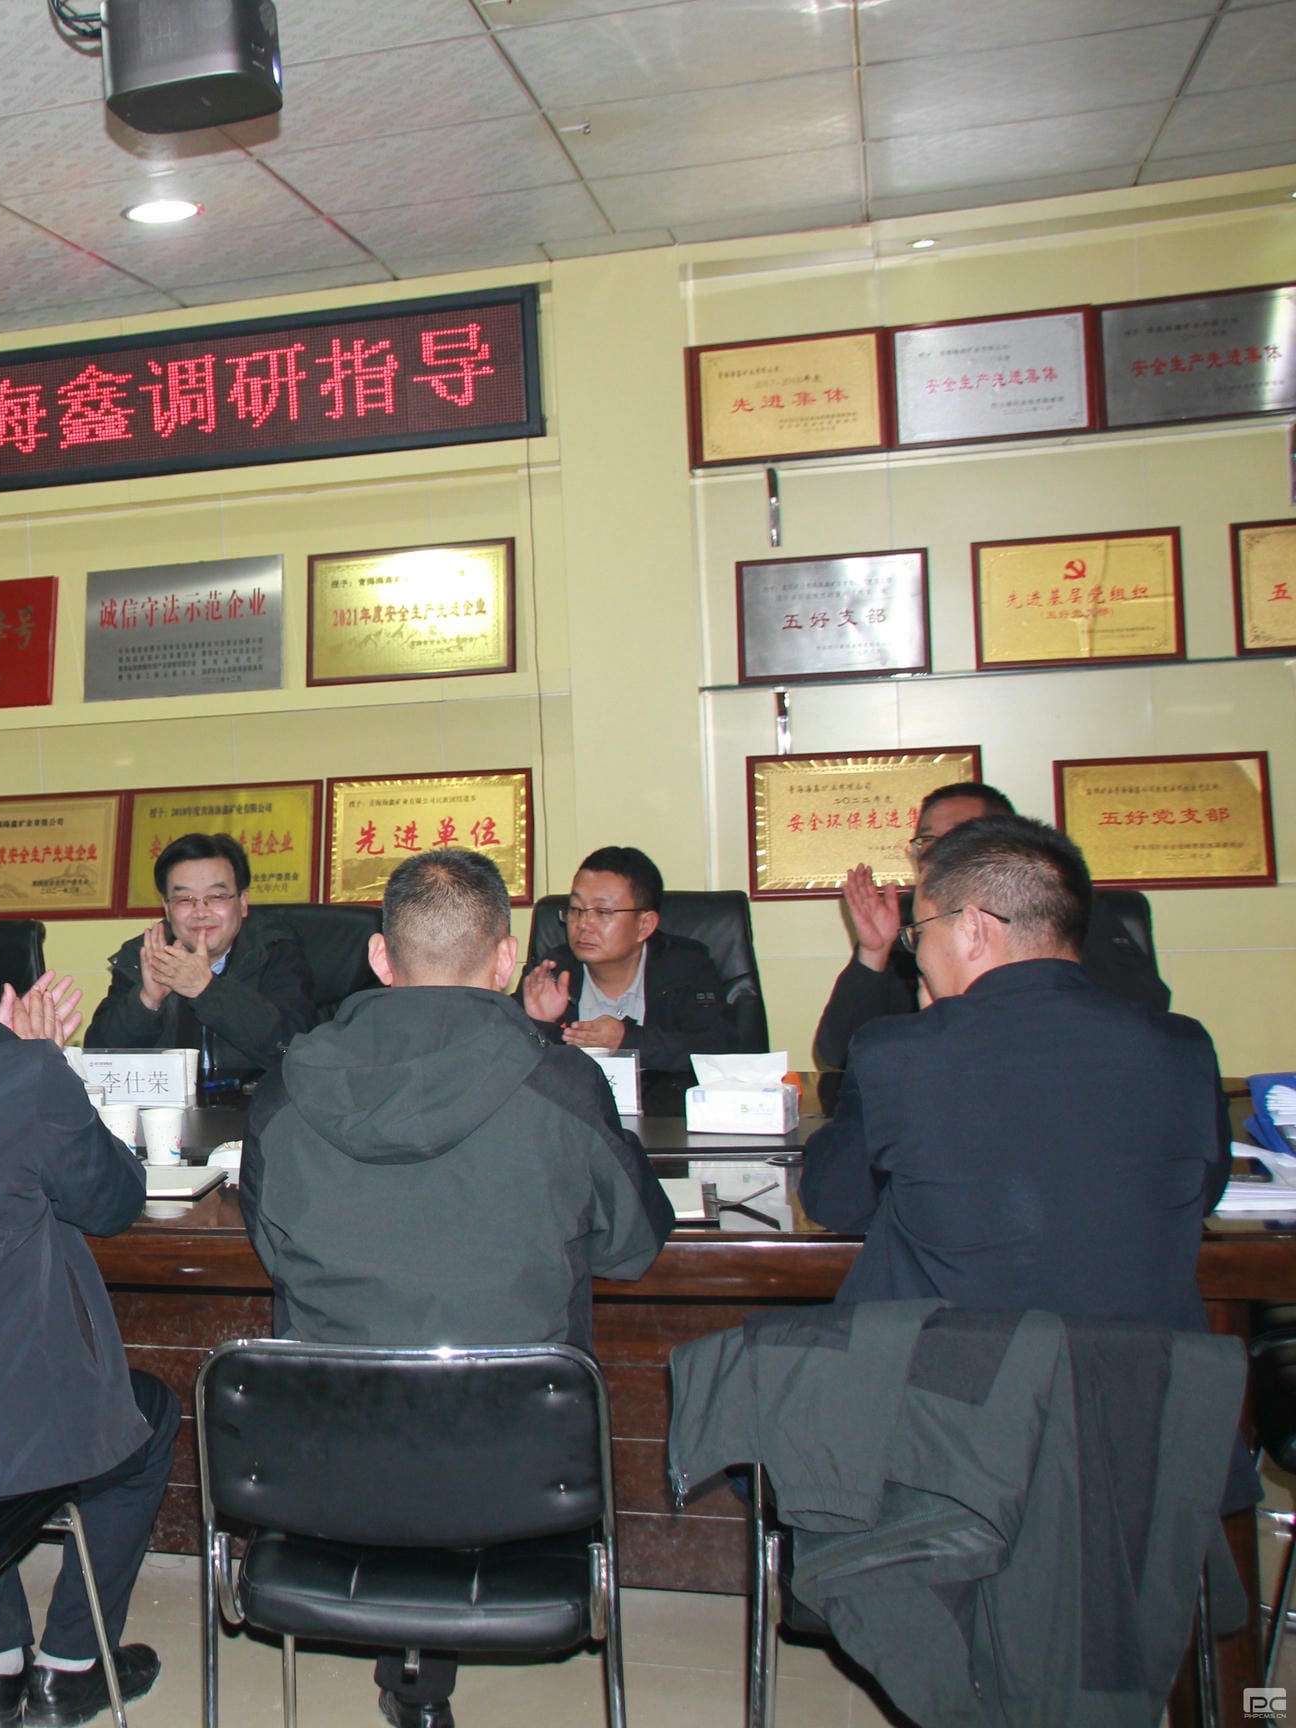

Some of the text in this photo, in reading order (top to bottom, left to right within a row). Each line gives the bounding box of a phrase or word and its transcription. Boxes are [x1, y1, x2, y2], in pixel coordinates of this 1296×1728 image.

[1131, 344, 1282, 377] 安全生产先进集体
[925, 366, 1058, 394] 安全生产先进集体
[731, 386, 849, 414] 先进集体
[1006, 583, 1150, 609] 先进基层党组织
[1266, 582, 1294, 602] 五
[98, 586, 267, 631] 诚信守法示范企业
[781, 607, 888, 632] 五好支部
[1098, 806, 1231, 827] 五好党支部
[355, 815, 501, 855] 先进单位
[99, 1070, 170, 1095] 李仕荣
